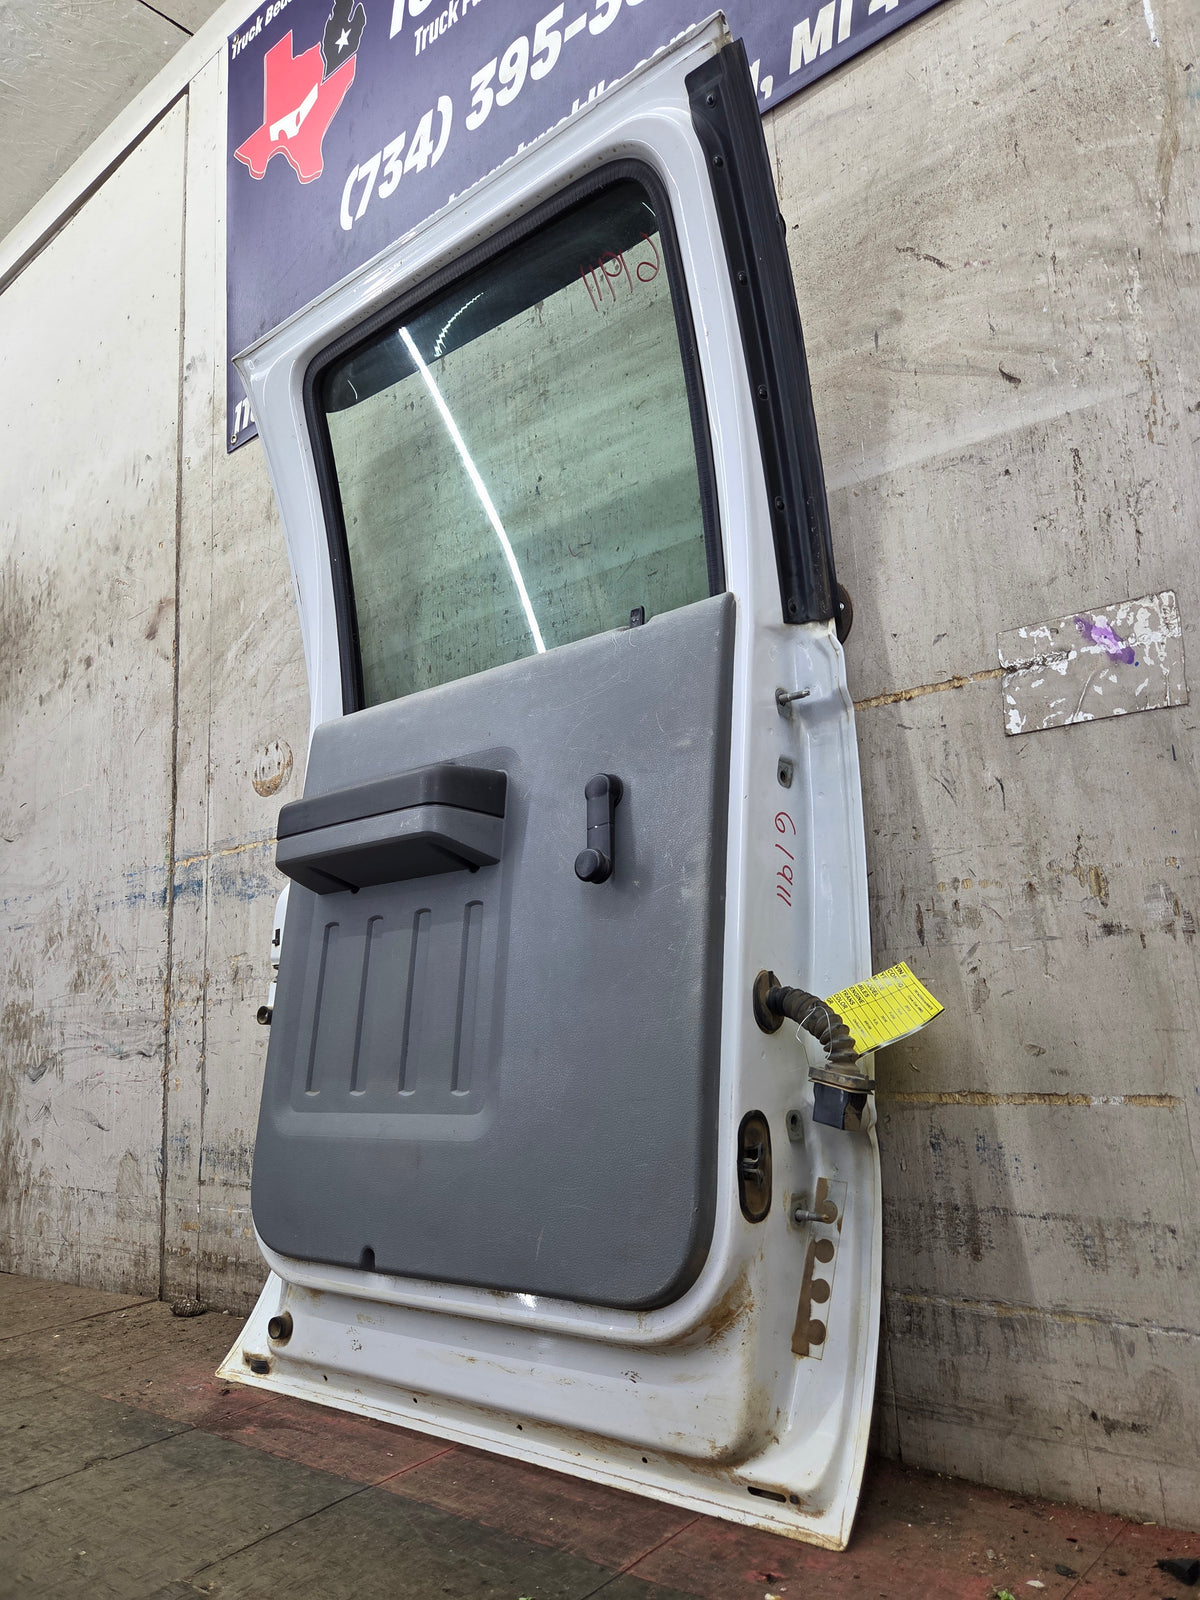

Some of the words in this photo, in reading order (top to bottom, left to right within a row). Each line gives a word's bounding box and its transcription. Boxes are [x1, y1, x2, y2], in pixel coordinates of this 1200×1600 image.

[231, 16, 264, 60] Truck
[265, 0, 292, 27] Be
[414, 0, 459, 57] Truck
[789, 0, 853, 75] MI
[340, 95, 453, 230] (734)
[466, 0, 644, 130] 395-
[774, 811, 796, 907] 61911
